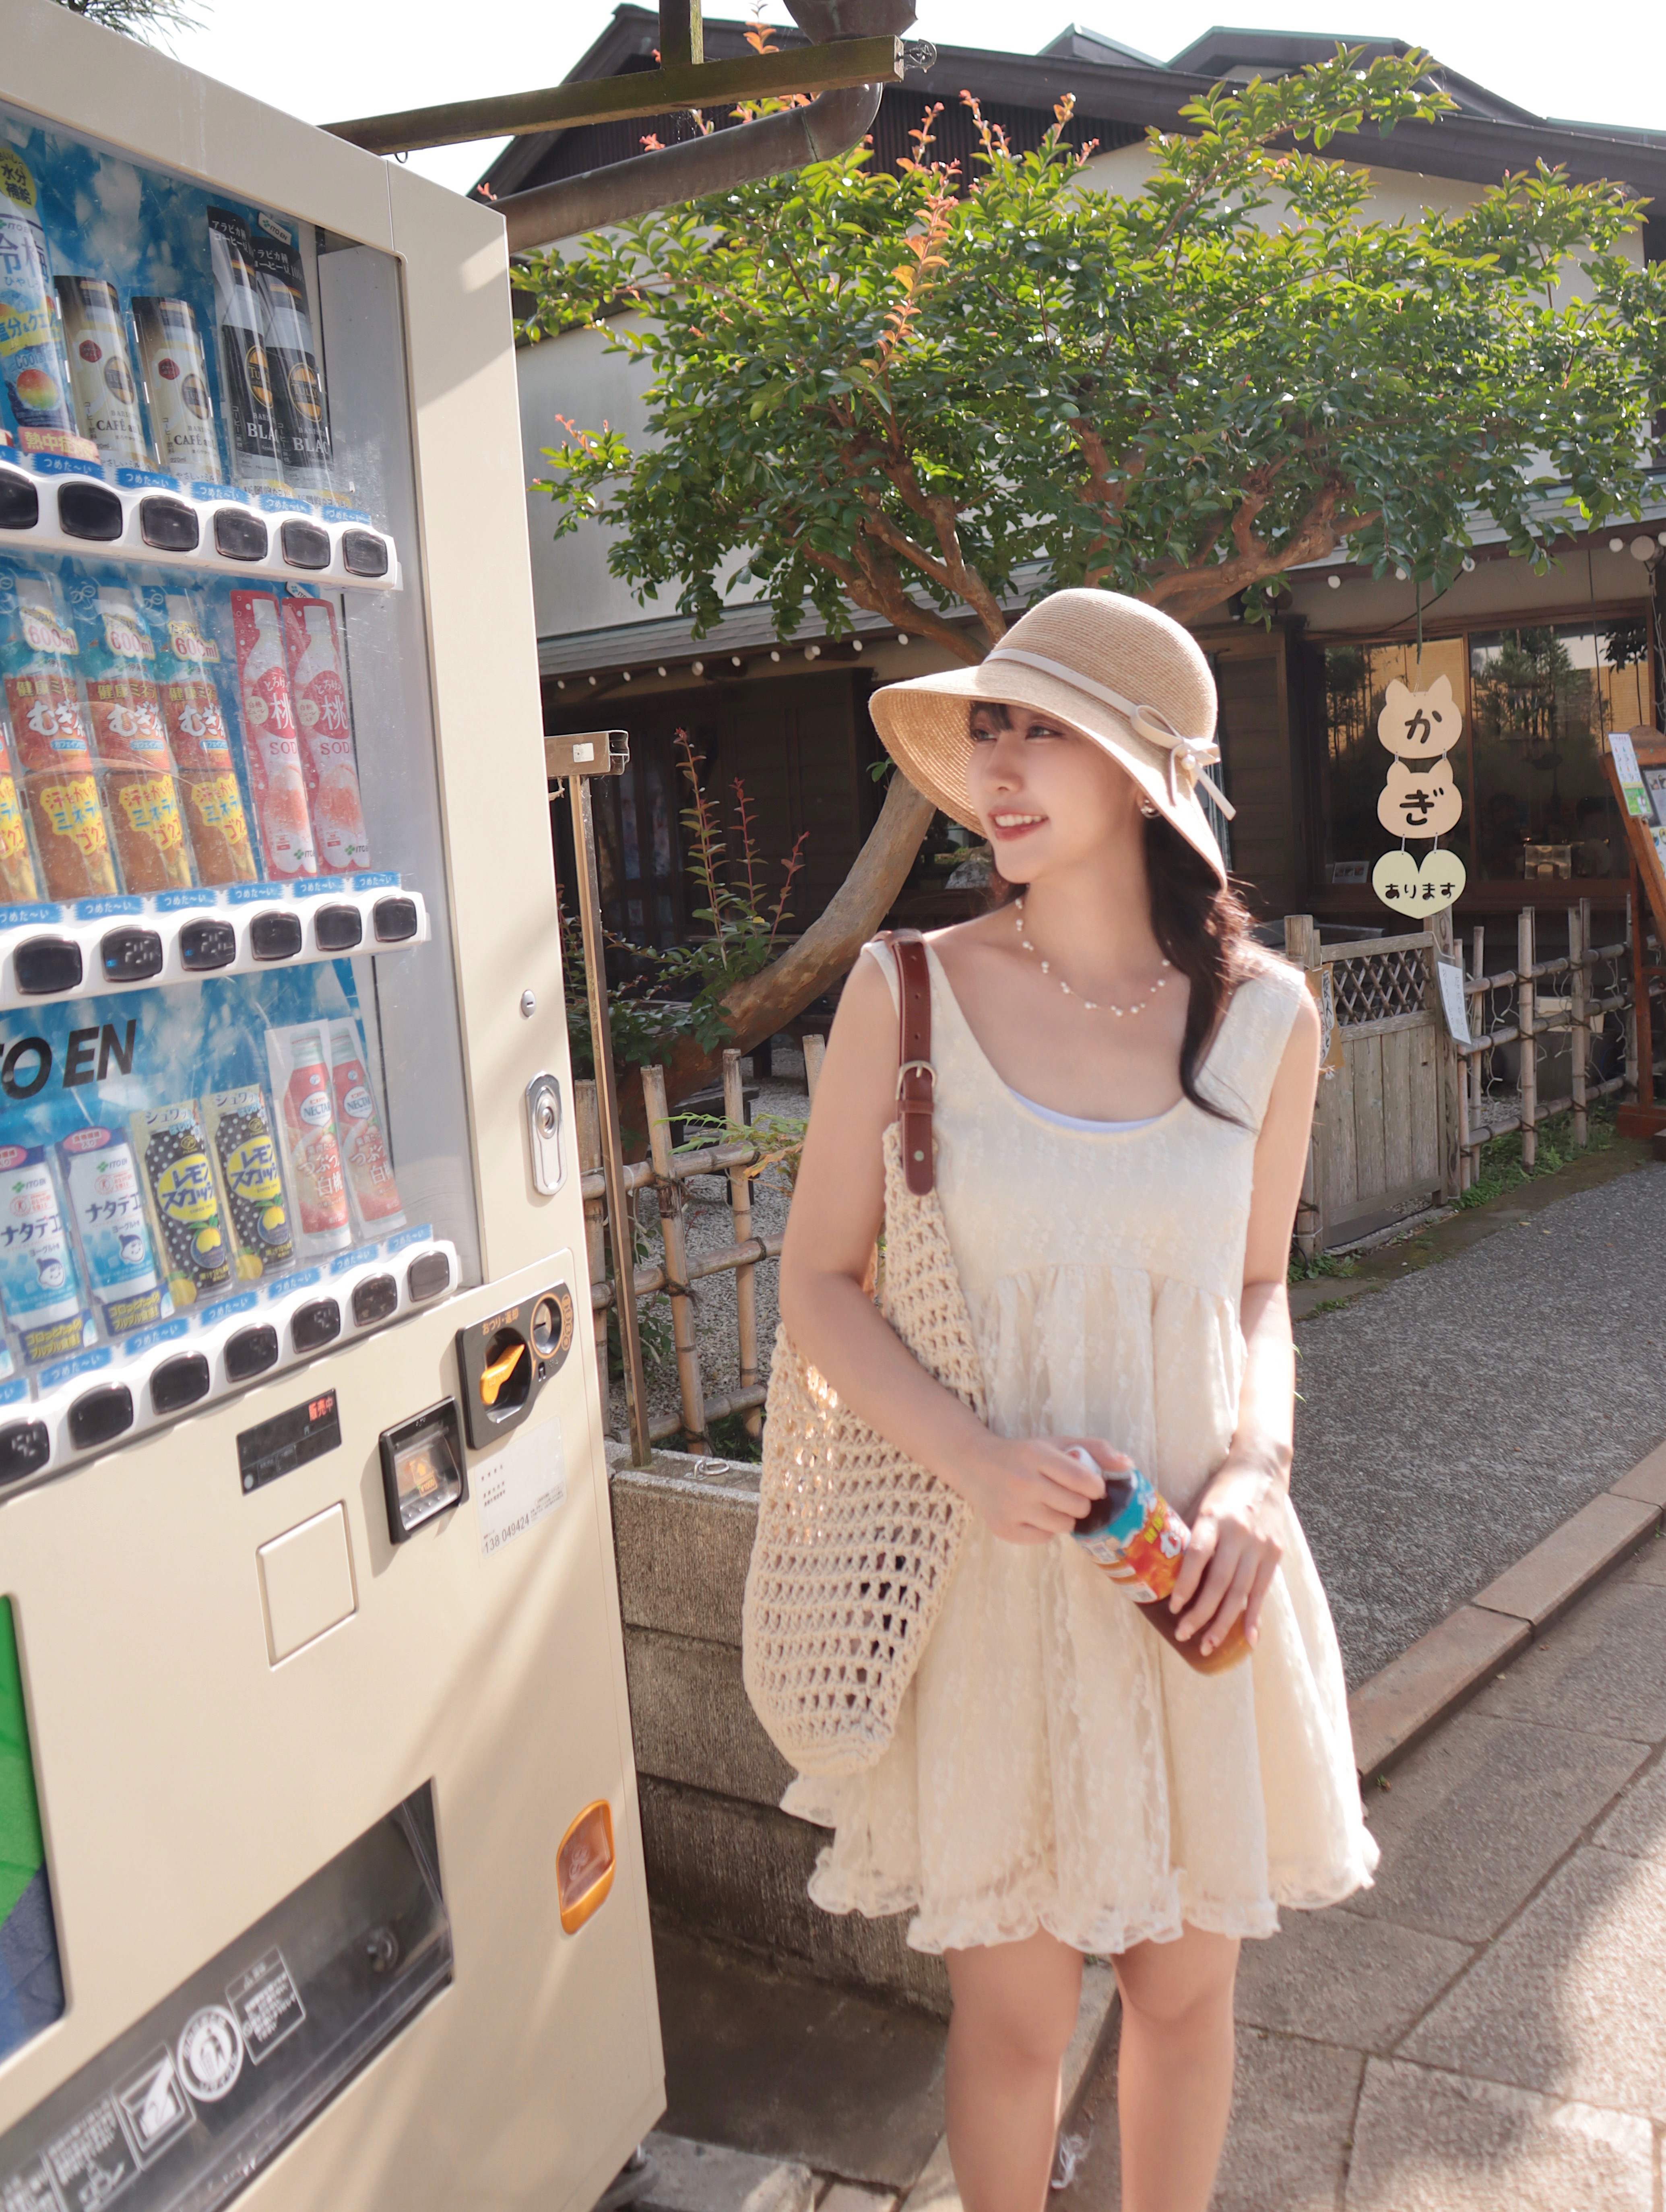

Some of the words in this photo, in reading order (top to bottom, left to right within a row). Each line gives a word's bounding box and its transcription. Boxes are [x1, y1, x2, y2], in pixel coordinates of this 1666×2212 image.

[1, 163, 26, 186] 水分
[270, 226, 280, 235] ITO
[280, 233, 288, 241] EN
[254, 249, 289, 264] ラビカ種
[96, 419, 126, 431] CAFÉ
[174, 433, 202, 446] CAFÉ
[28, 624, 76, 650] 600ml
[110, 631, 154, 655] 600ml
[175, 637, 218, 659] 600ml
[270, 692, 295, 730] 桃
[321, 694, 349, 731] 桃
[1385, 882, 1455, 900] あります
[0, 1037, 52, 1100] O
[62, 1018, 136, 1089] EN
[297, 1154, 340, 1176] つぶつ
[350, 1144, 387, 1165] つぶつ
[317, 1173, 343, 1198] 白桃
[485, 1534, 500, 1553] 138
[502, 1513, 529, 1542] 049424
